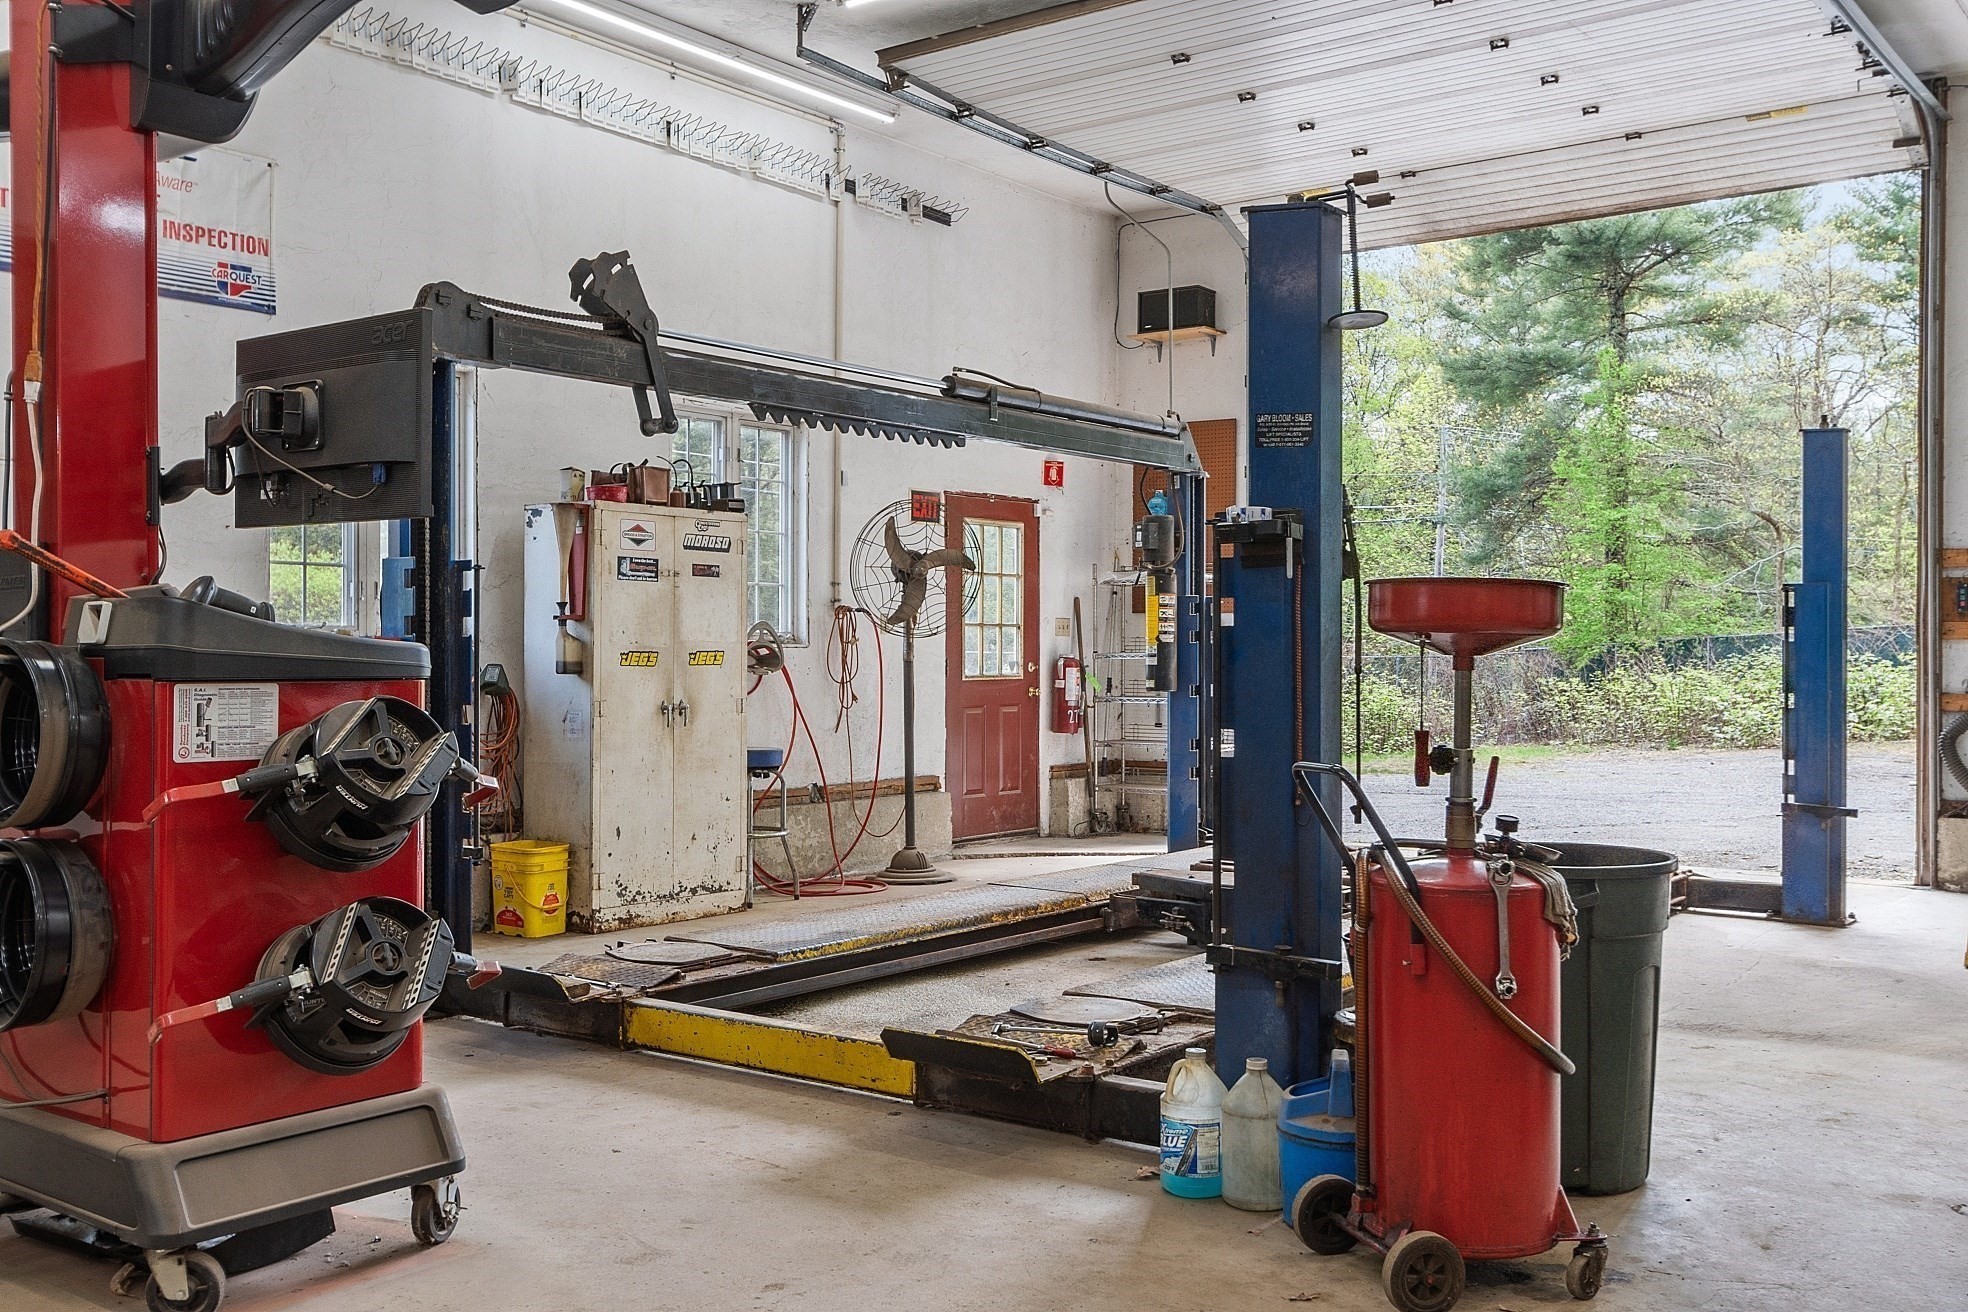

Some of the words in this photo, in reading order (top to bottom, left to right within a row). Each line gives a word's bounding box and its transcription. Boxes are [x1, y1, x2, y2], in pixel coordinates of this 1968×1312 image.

[162, 219, 269, 256] INSPECTION
[211, 268, 262, 285] CARQUEST
[370, 320, 413, 345] acer
[1257, 414, 1271, 422] GARY
[1294, 414, 1312, 422] SALES
[912, 494, 939, 519] EXIT
[683, 534, 731, 550] MOROSO
[1067, 709, 1079, 724] 27
[335, 785, 368, 810] HUNTER
[346, 1008, 382, 1025] HUNTER
